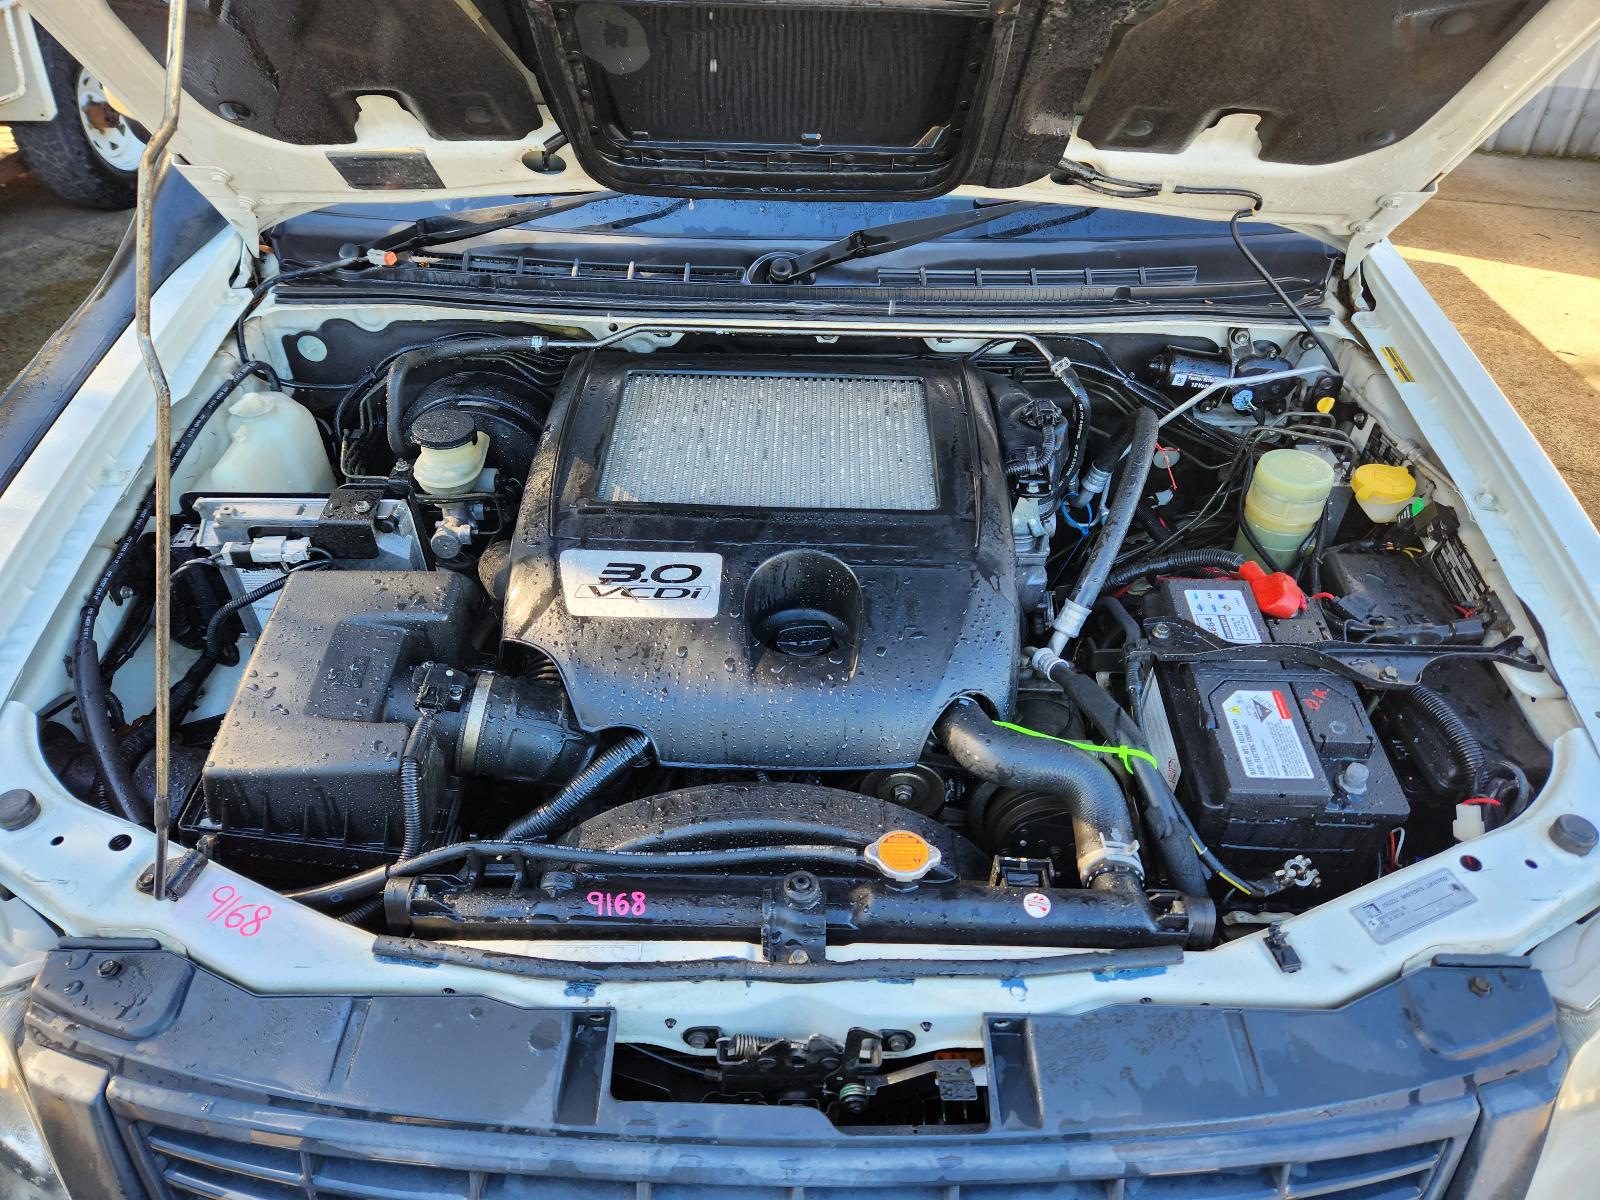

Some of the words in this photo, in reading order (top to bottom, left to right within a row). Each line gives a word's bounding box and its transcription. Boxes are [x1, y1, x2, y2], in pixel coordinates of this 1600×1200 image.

[598, 562, 702, 584] 3.0
[588, 586, 702, 600] VCDi
[207, 885, 272, 937] 9168
[587, 891, 646, 916] 9168
